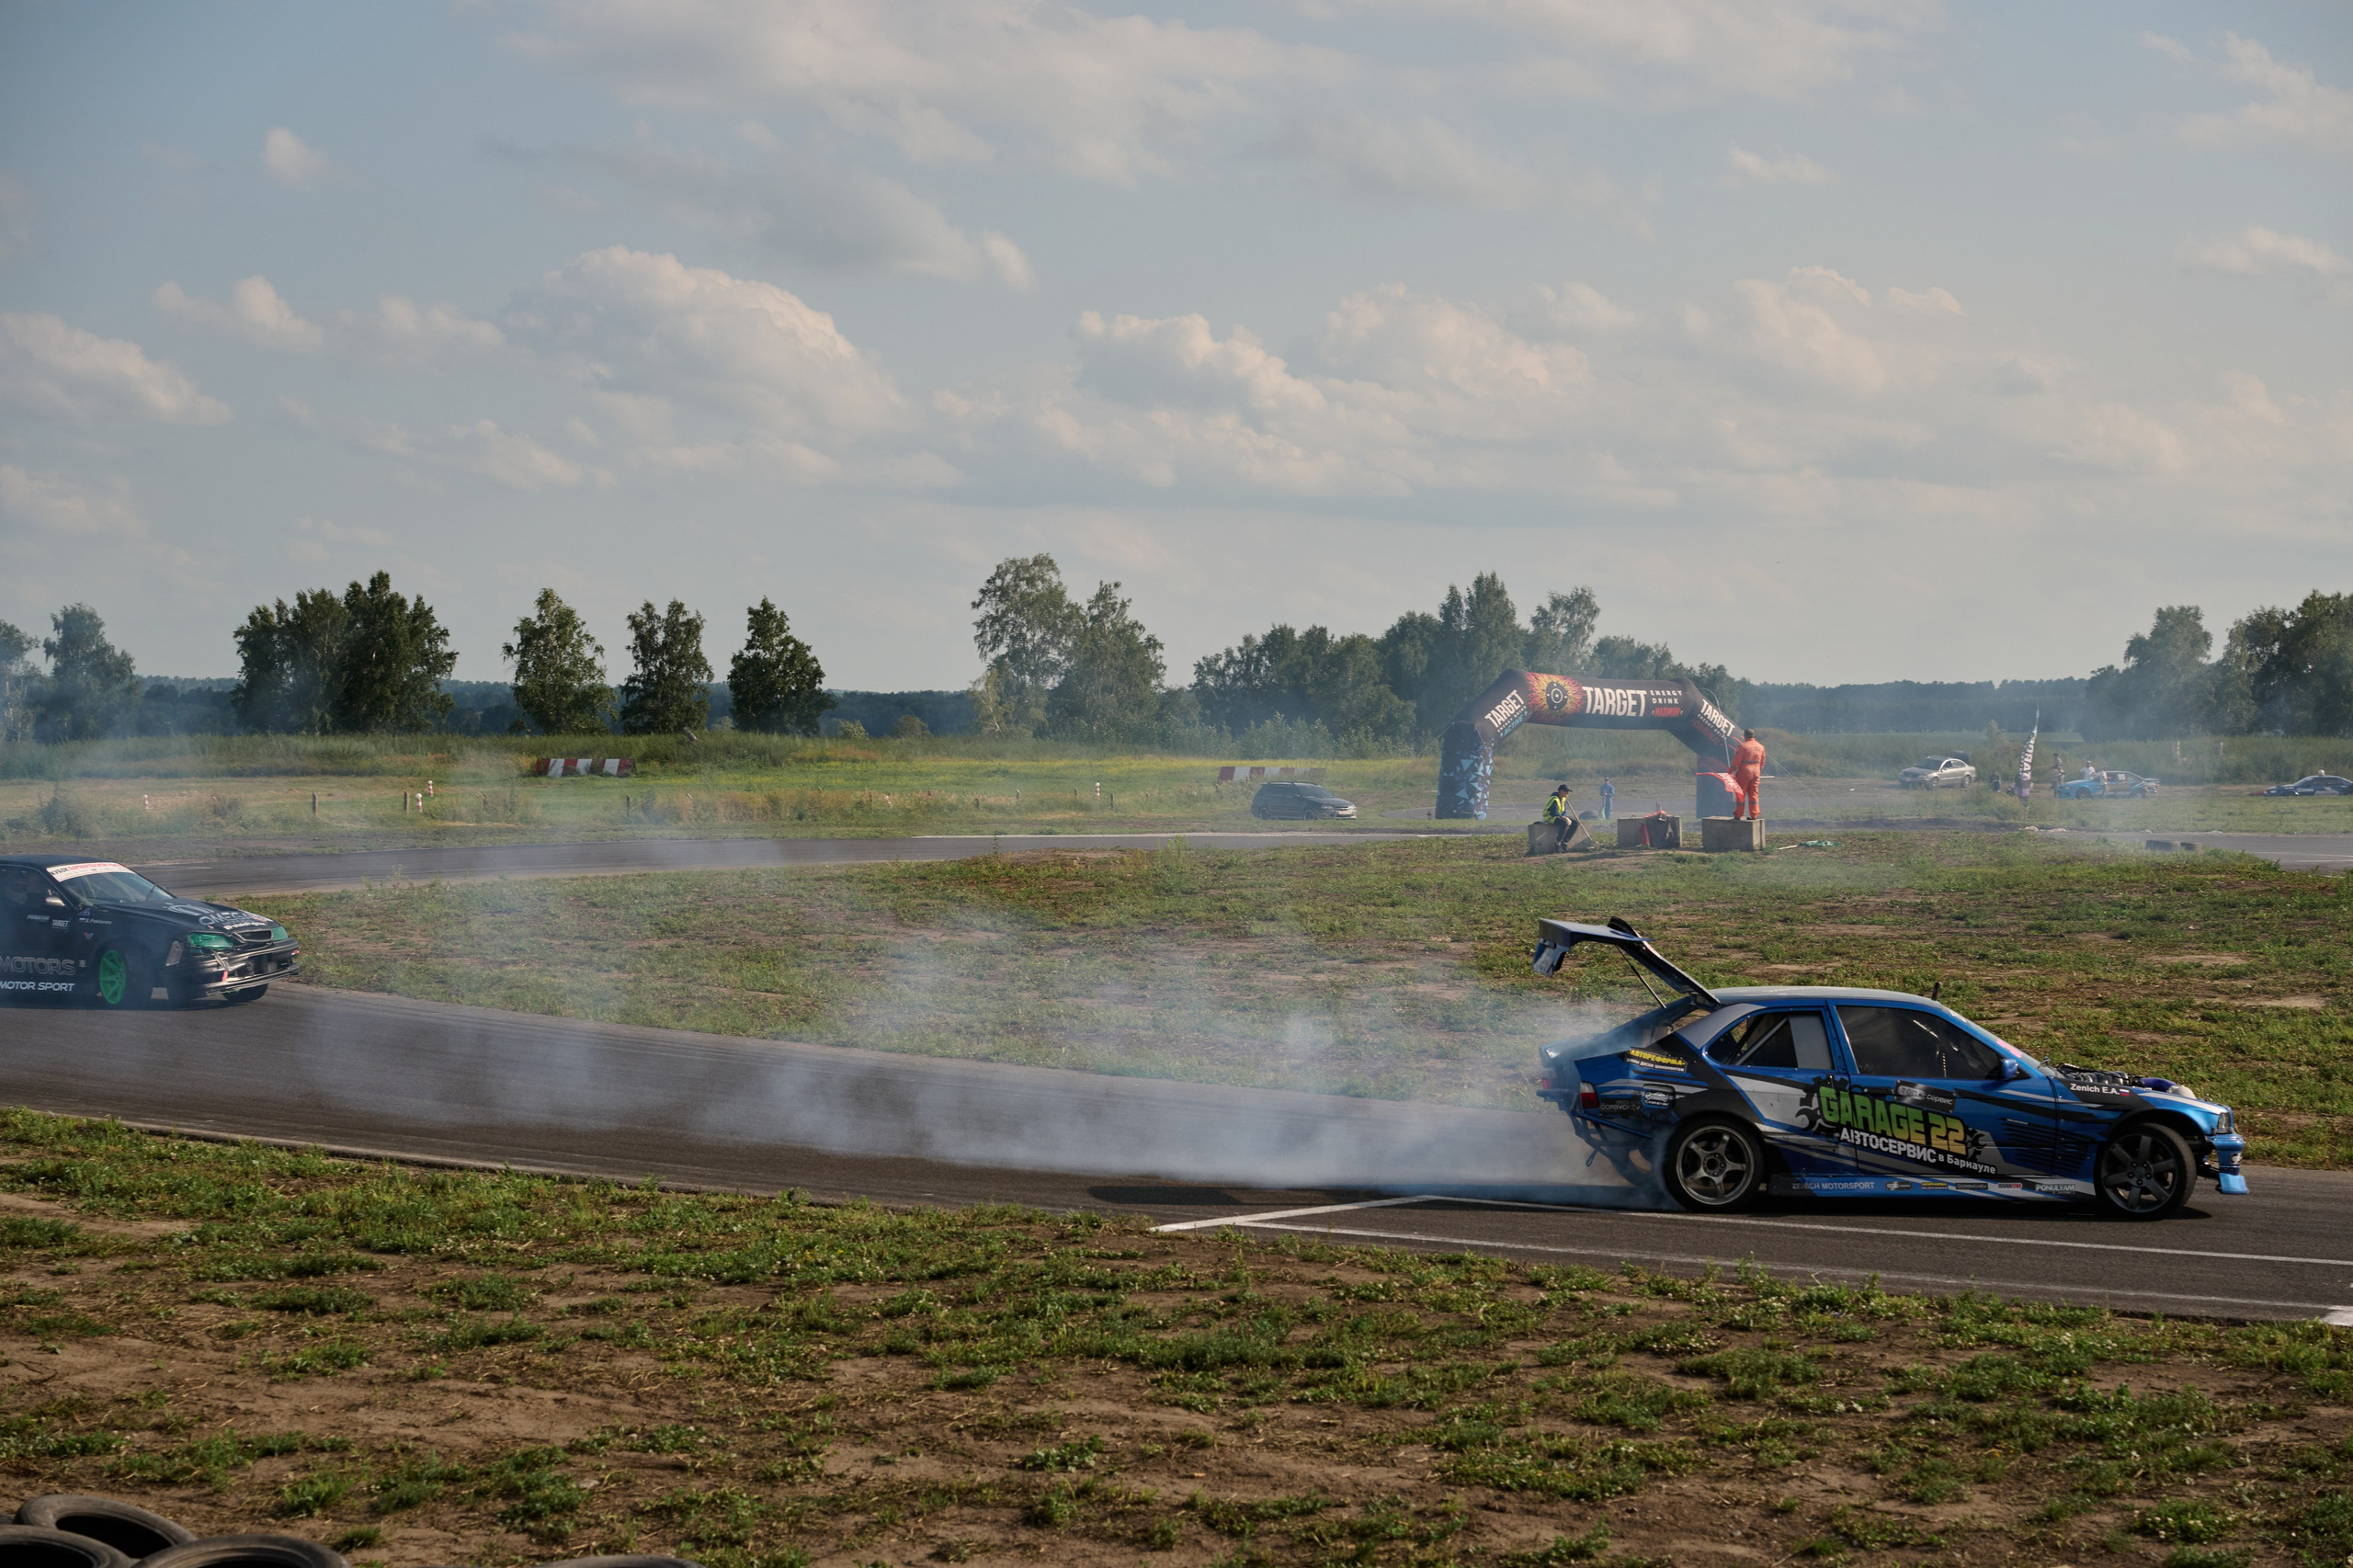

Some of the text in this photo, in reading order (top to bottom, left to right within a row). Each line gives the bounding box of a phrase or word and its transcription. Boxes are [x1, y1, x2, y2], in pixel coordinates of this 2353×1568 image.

[1483, 689, 1525, 728] TARGET
[1582, 686, 1647, 717] TARGET
[1503, 714, 1524, 736] ACTIVE
[1700, 699, 1735, 737] TARGET
[37, 982, 75, 992] SPORT
[1926, 1094, 1953, 1106] сервис
[2070, 1083, 2120, 1095] Zenich E.A.
[1819, 1085, 1968, 1156] GARAGE 22
[1839, 1127, 1996, 1175] АВТОСЕРВИС в Барнауле
[1791, 1181, 1875, 1190] ZENICH MOTORSPORT
[2035, 1184, 2075, 1192] PONULYAM
